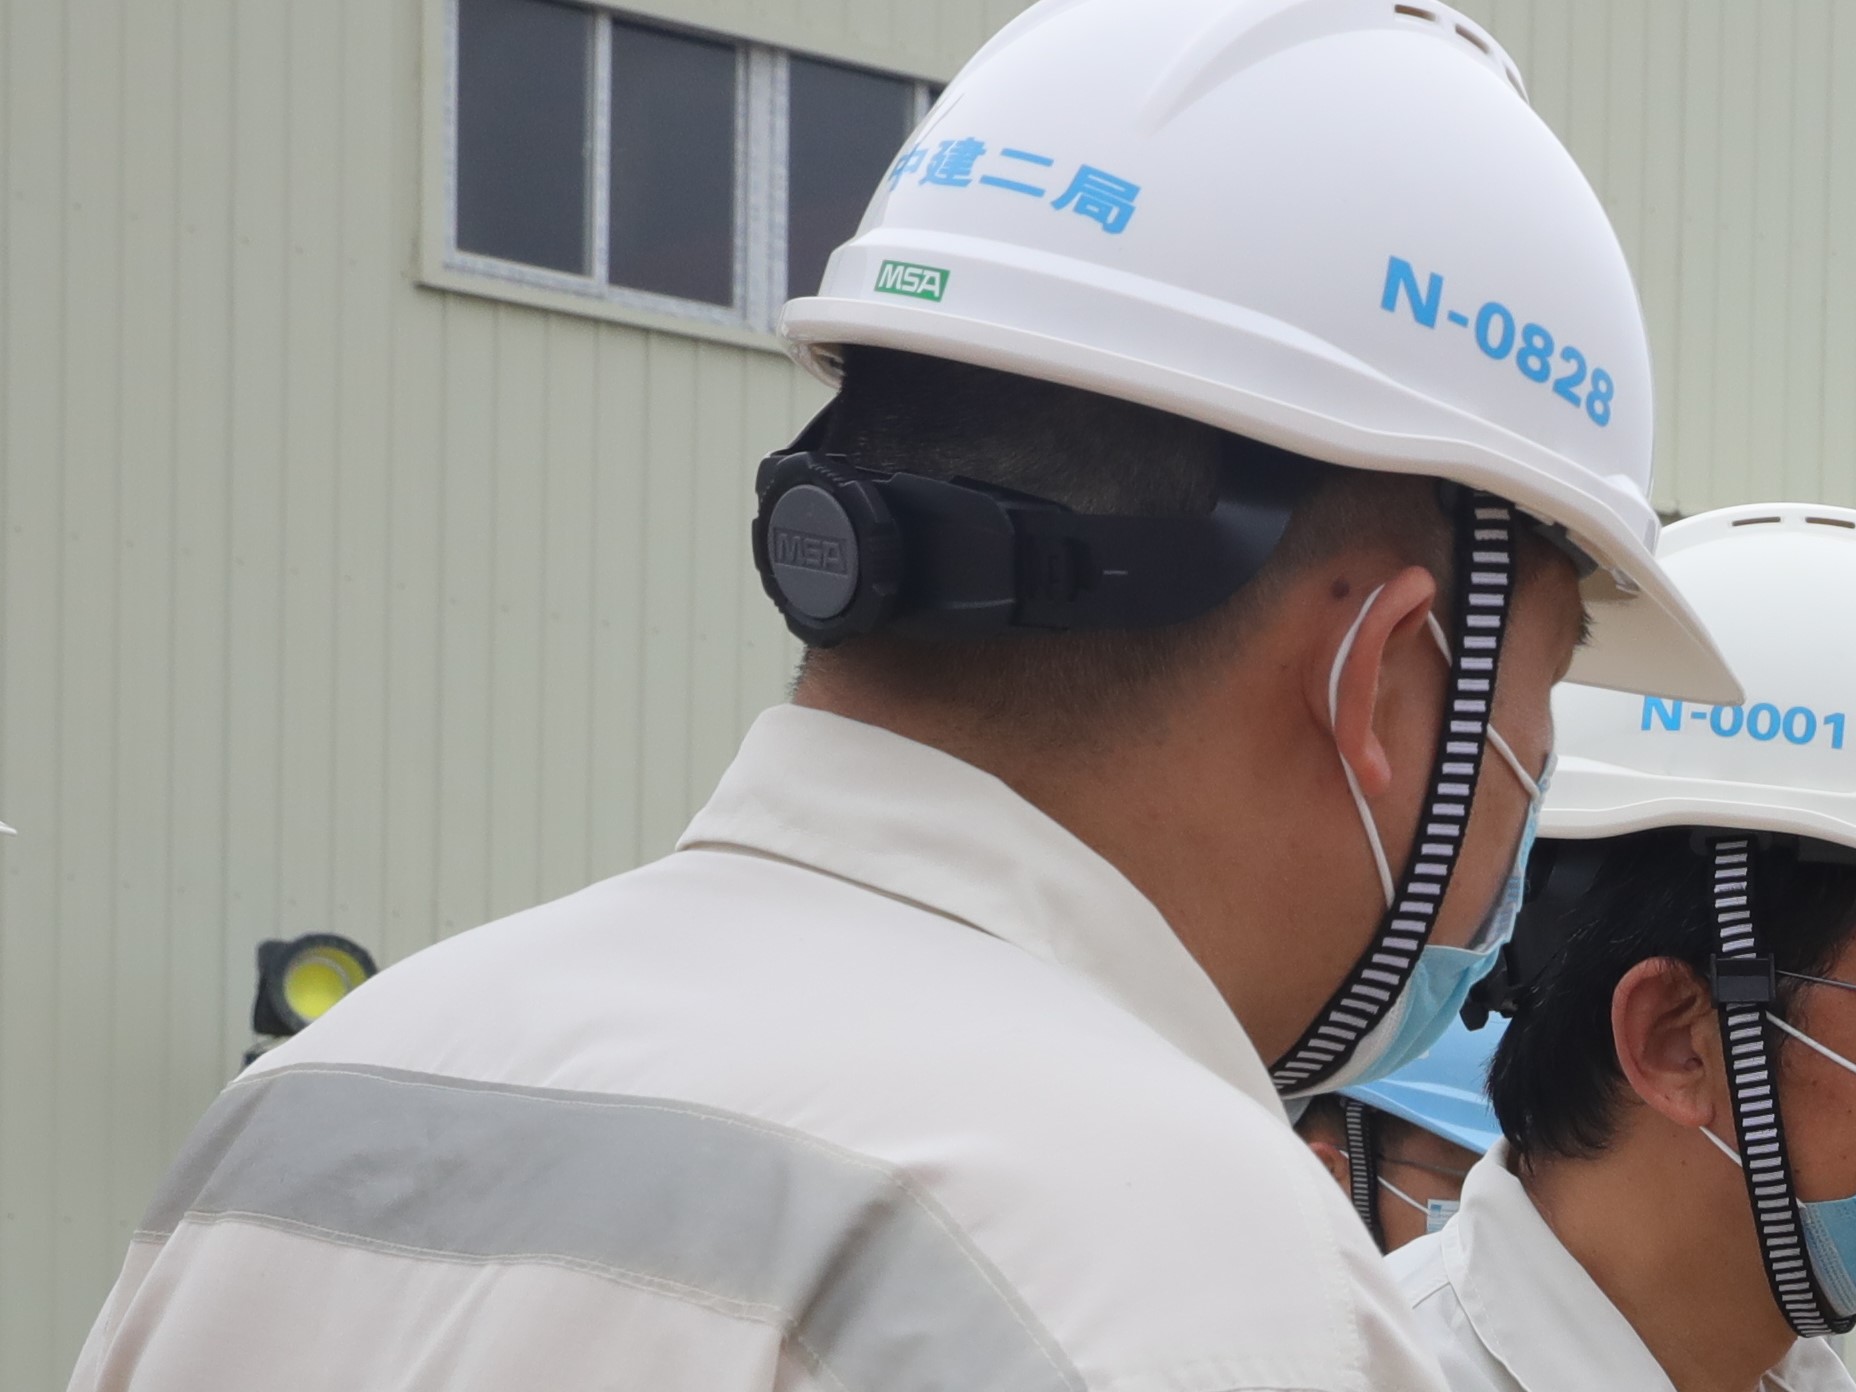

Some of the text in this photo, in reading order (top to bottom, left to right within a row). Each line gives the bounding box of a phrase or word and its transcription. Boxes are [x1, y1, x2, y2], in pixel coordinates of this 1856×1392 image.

[877, 262, 942, 299] MSA
[1380, 255, 1616, 429] N-0828
[1640, 694, 1847, 750] N-0001
